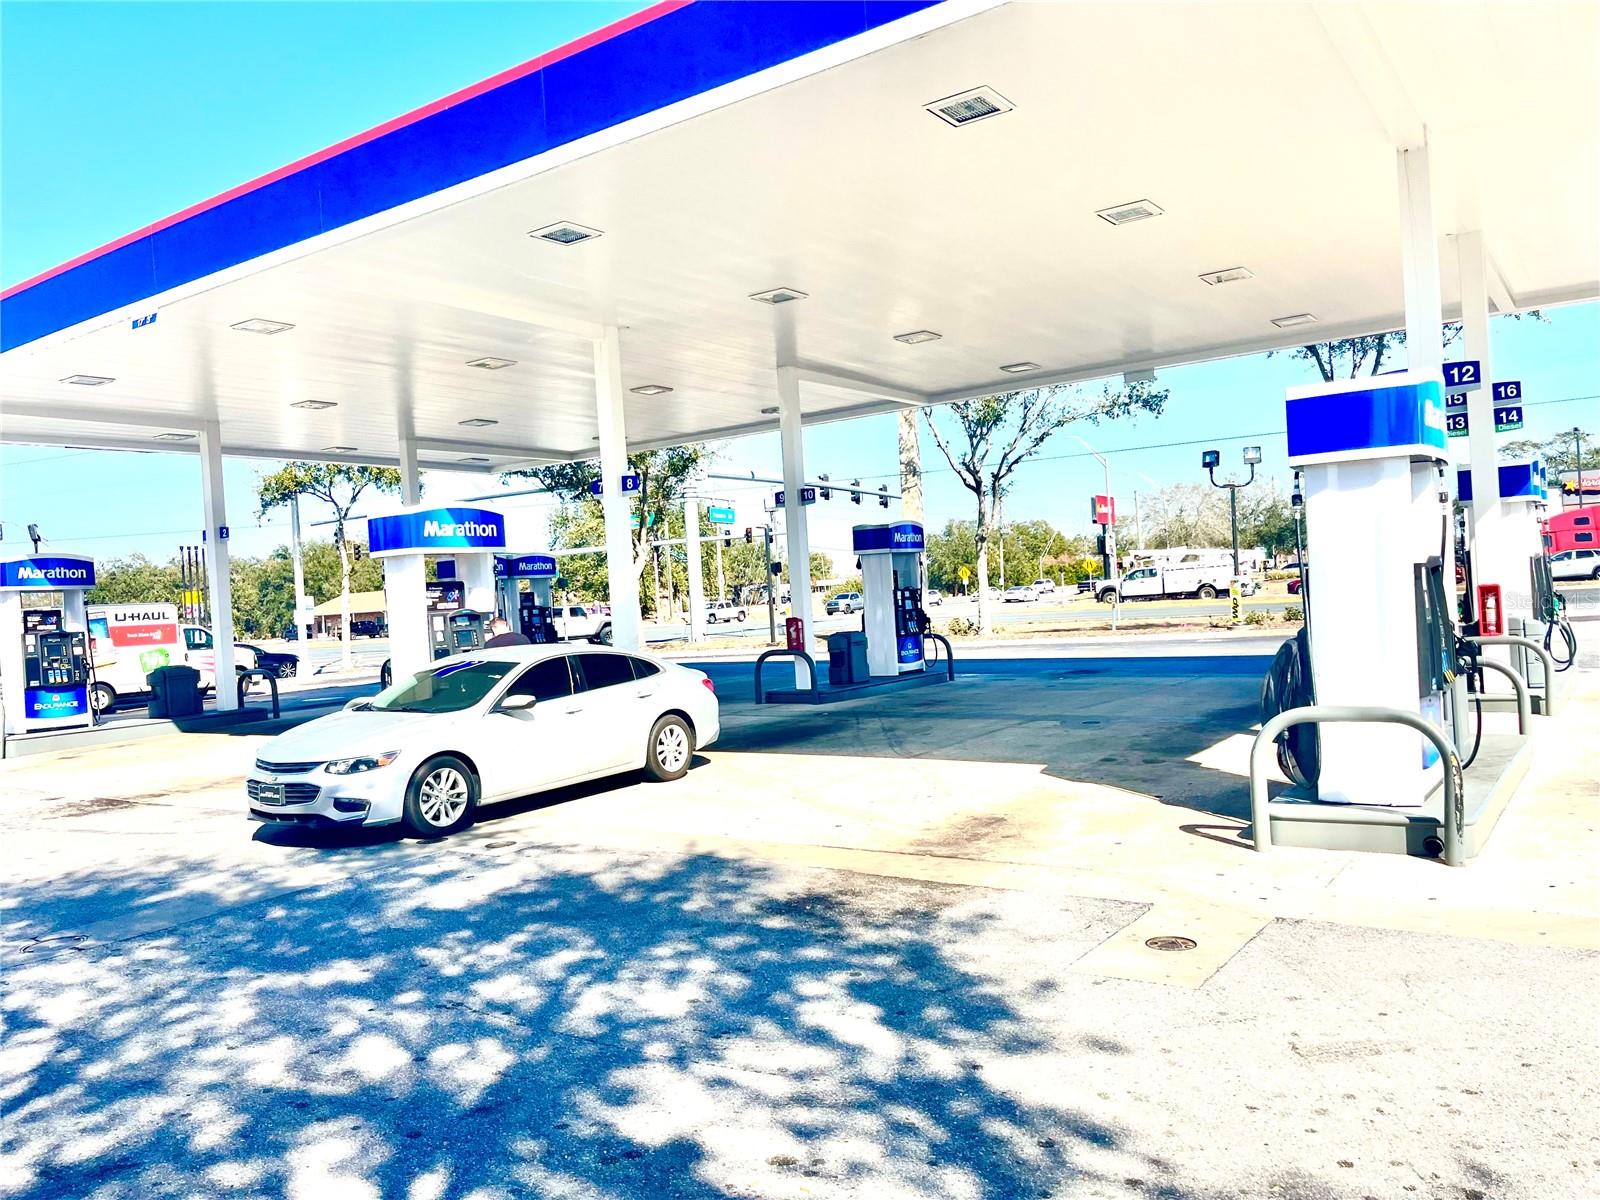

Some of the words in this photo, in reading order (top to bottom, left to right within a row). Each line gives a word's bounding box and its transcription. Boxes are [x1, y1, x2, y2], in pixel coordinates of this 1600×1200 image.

[1449, 365, 1475, 383] 12
[1498, 384, 1517, 398] 16
[1446, 393, 1464, 405] 15
[1500, 410, 1518, 423] 14
[1446, 416, 1465, 430] 13
[1499, 422, 1521, 431] Diesel
[1447, 429, 1467, 437] Diesel
[626, 478, 634, 489] 8
[779, 493, 785, 503] 9
[803, 490, 813, 500] 10
[222, 529, 227, 537] 2
[423, 520, 498, 538] Marathon
[894, 532, 922, 543] Marathon
[518, 561, 553, 571] Marathon
[18, 566, 87, 580] Marathon
[114, 611, 170, 622] U-HAUL
